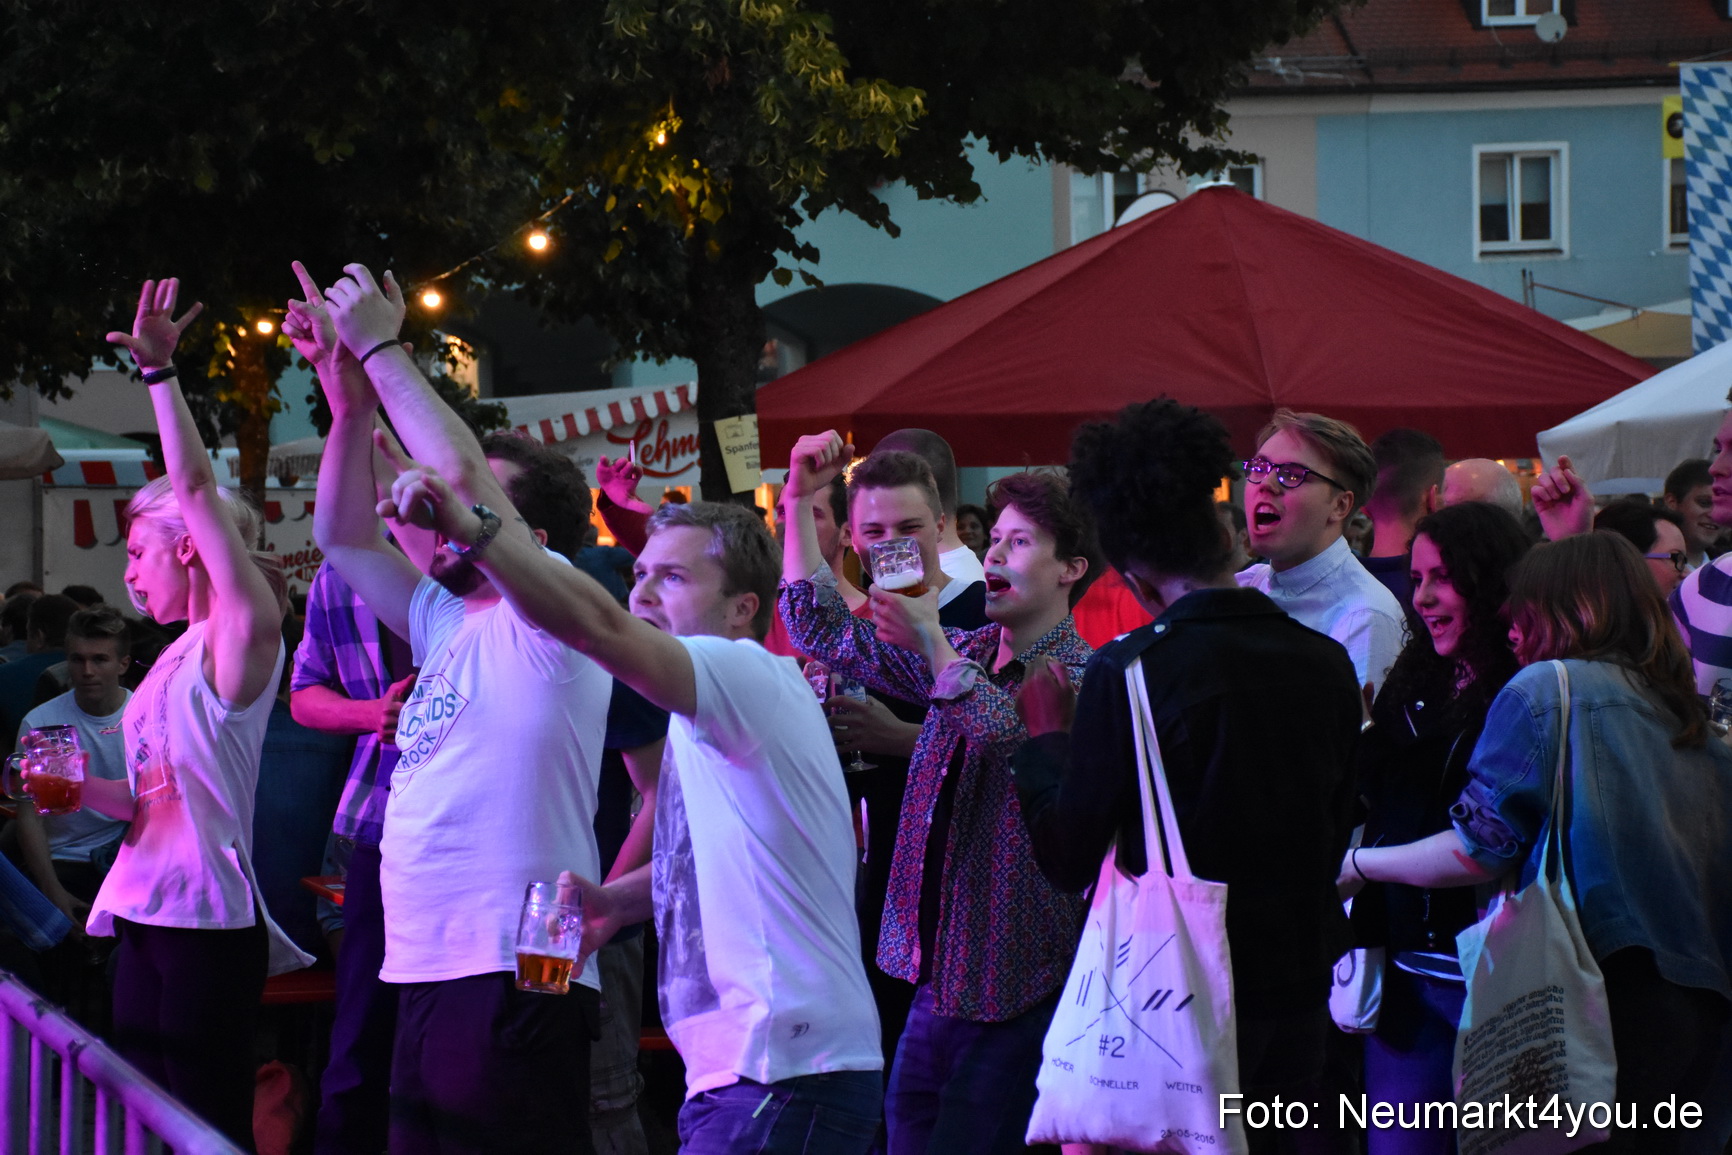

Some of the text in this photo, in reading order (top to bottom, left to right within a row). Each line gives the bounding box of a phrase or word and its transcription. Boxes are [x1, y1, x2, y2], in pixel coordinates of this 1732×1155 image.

[606, 417, 701, 474] Lehm
[724, 441, 760, 455] Spanfe
[1098, 1034, 1125, 1058] #2
[1089, 1075, 1139, 1090] SCHNELLER
[1165, 1081, 1203, 1094] WEITER
